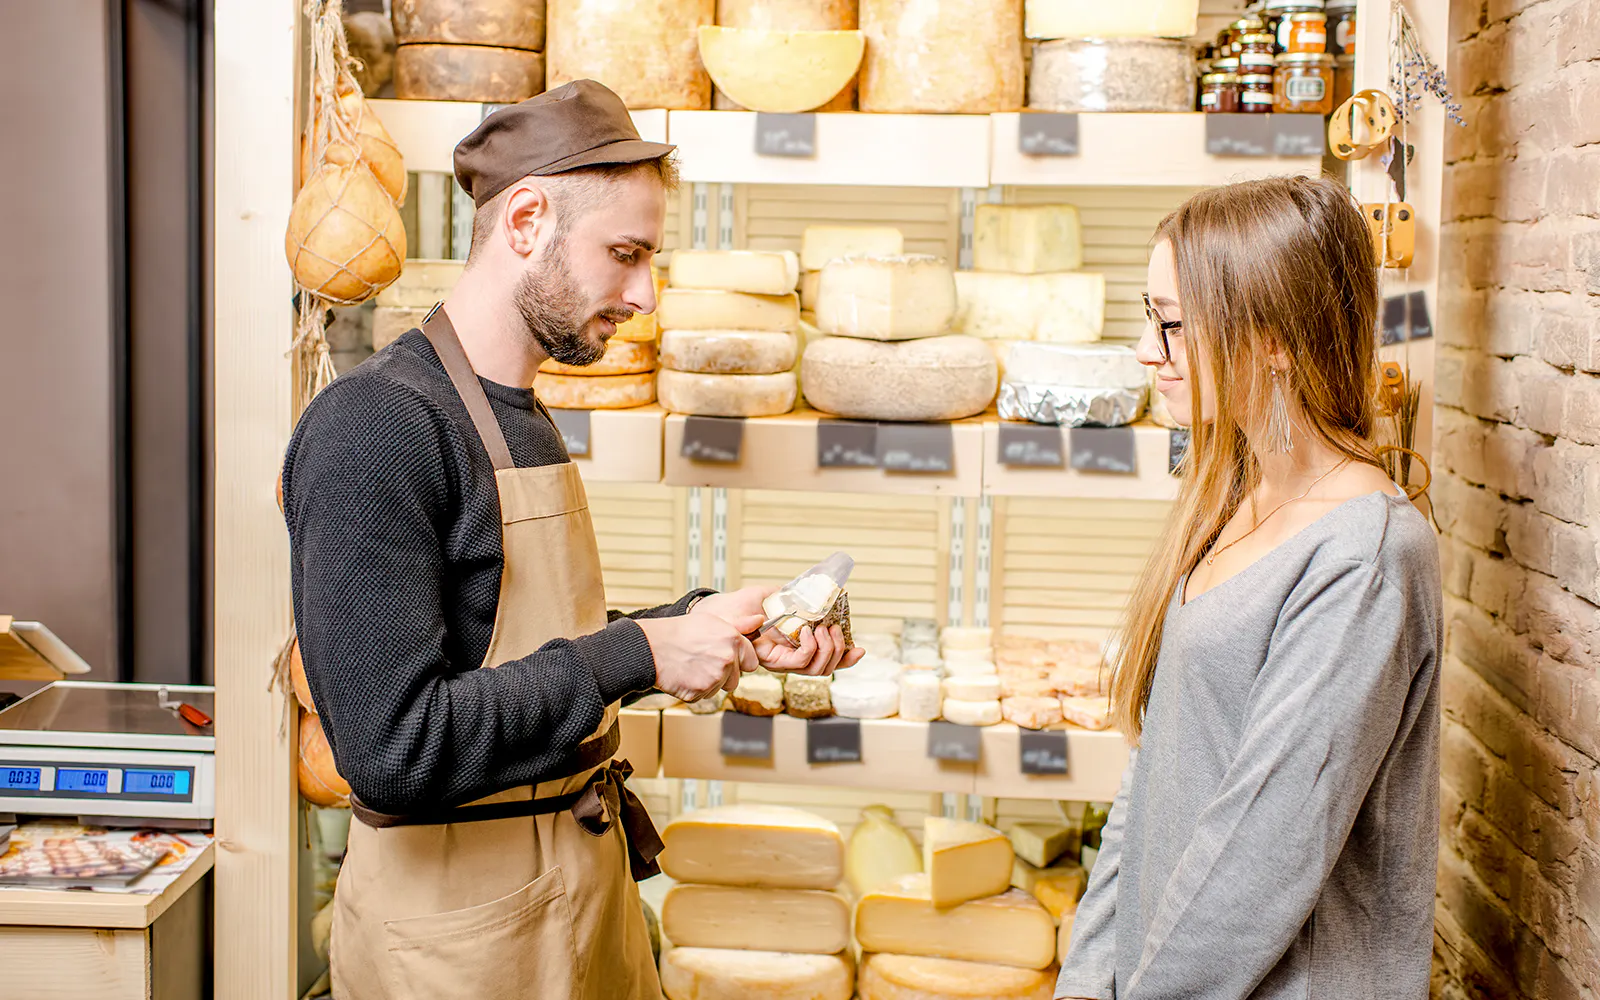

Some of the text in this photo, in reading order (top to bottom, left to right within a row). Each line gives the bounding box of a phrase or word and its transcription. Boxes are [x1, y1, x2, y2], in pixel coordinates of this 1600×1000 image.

[8, 770, 40, 784] 0.033
[83, 772, 107, 786] 0.00
[150, 774, 174, 788] 0.00
